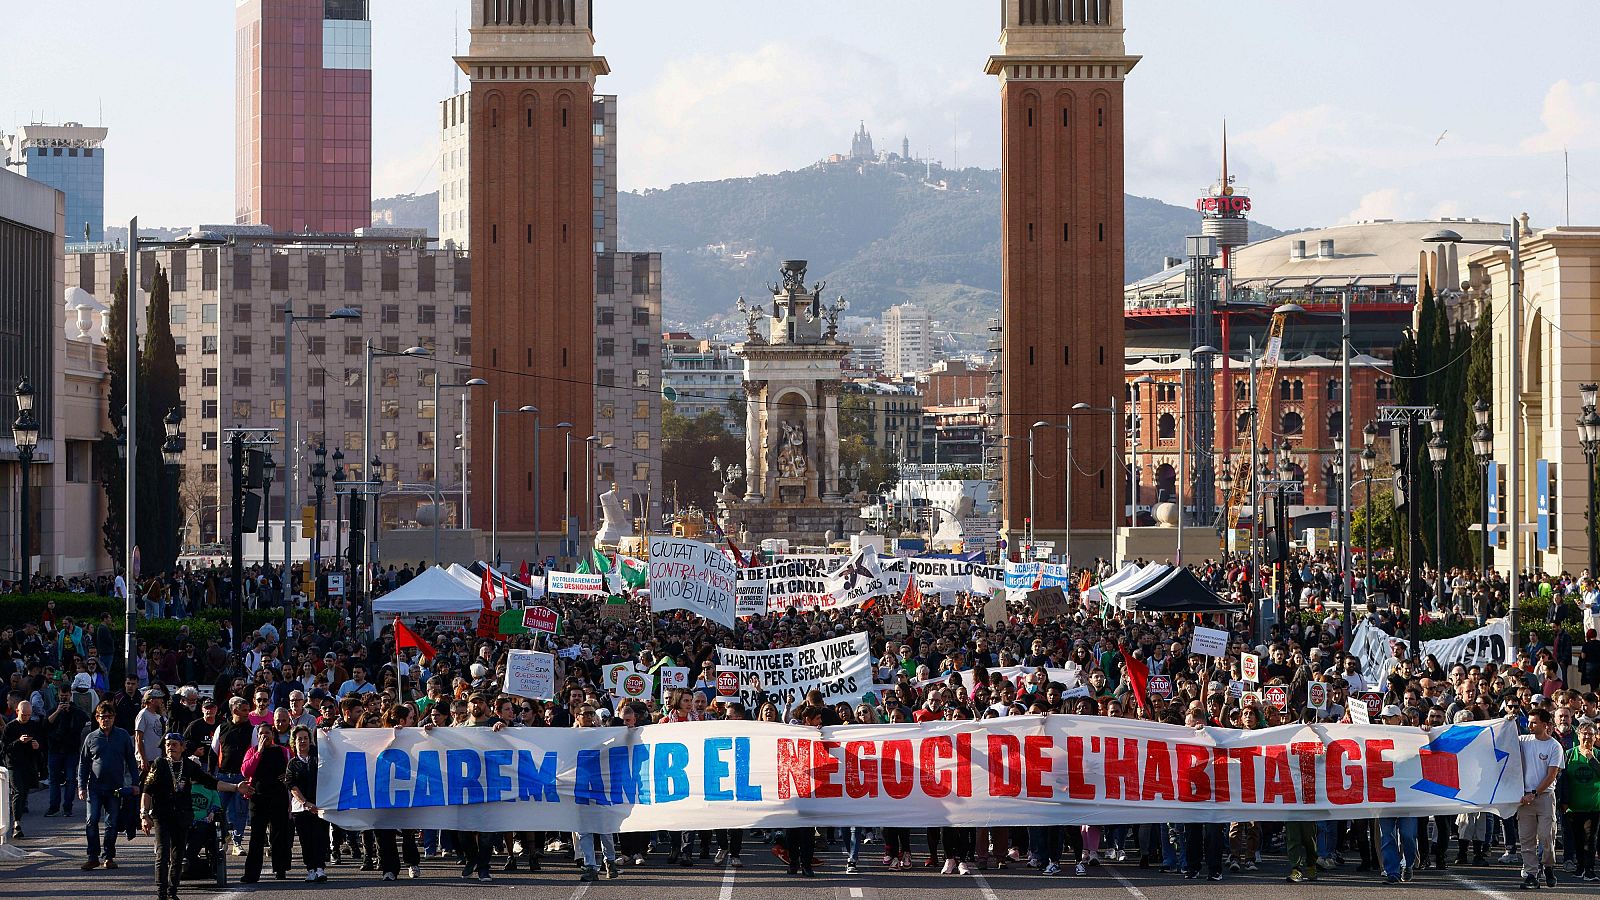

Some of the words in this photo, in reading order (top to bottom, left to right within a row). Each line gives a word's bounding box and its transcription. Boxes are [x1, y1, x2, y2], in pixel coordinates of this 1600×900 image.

[651, 562, 697, 581] CONTRA
[748, 569, 764, 581] DE
[910, 561, 949, 576] PODER
[770, 582, 786, 595] LA
[788, 580, 825, 594] CAIXA
[865, 578, 883, 594] 2025
[482, 614, 499, 626] STO
[533, 607, 551, 618] STOP
[798, 649, 818, 666] PER
[627, 679, 643, 687] STOP
[719, 678, 737, 686] STOP
[741, 671, 760, 685] NO
[764, 670, 788, 686] PER
[1267, 693, 1285, 701] STOP
[574, 742, 690, 805] AMB
[704, 736, 762, 801] EL
[777, 733, 972, 799] NEGOCI
[988, 735, 1053, 798] DE
[1067, 736, 1396, 805] L'HABITATGE
